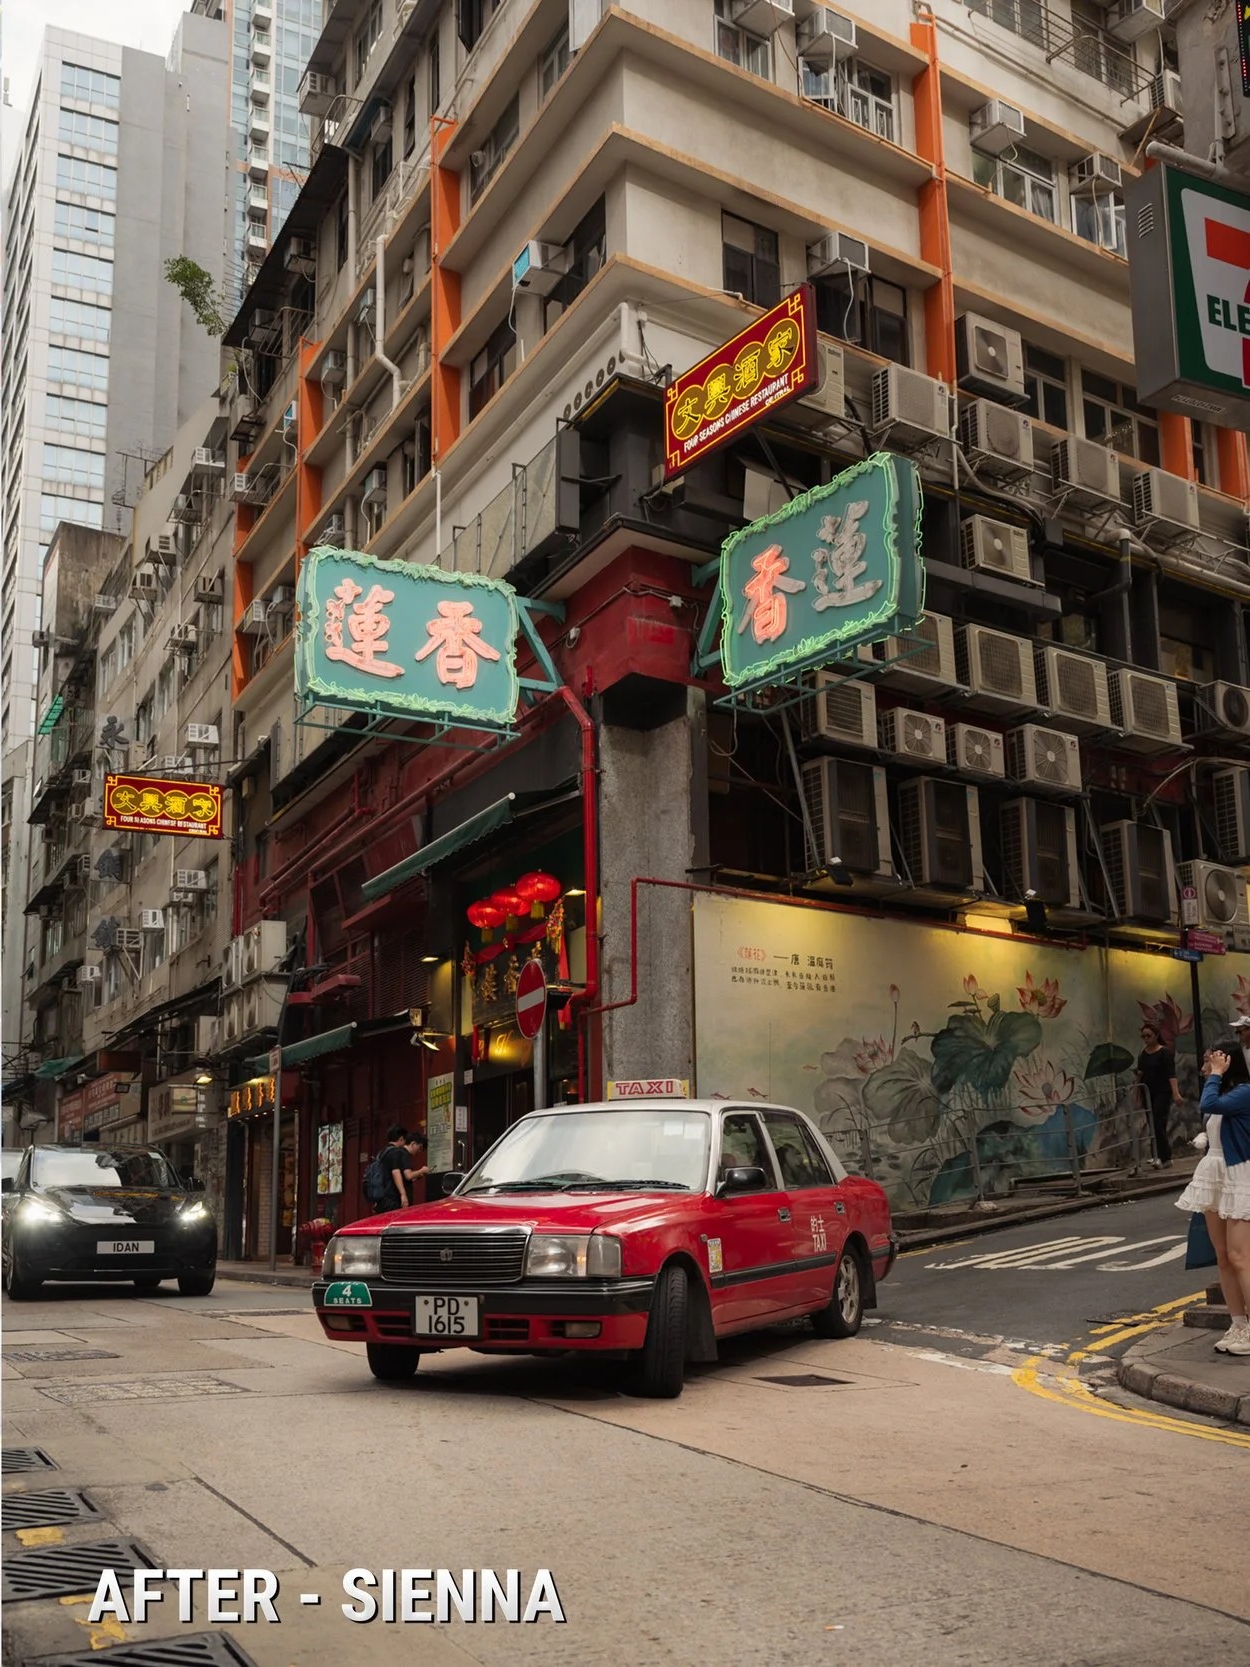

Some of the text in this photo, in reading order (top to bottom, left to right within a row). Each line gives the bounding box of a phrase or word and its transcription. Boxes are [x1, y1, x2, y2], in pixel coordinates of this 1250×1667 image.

[683, 373, 788, 453] FOUR SEASONS CHINESE RESTAURANT
[325, 578, 500, 689] 蓮香
[615, 1080, 673, 1096] TAXI
[809, 1214, 824, 1233] 的士
[812, 1233, 827, 1253] TAXI
[341, 1284, 351, 1297] 4
[332, 1297, 362, 1305] SEATS
[433, 1297, 460, 1316] PD
[428, 1315, 465, 1335] 1615
